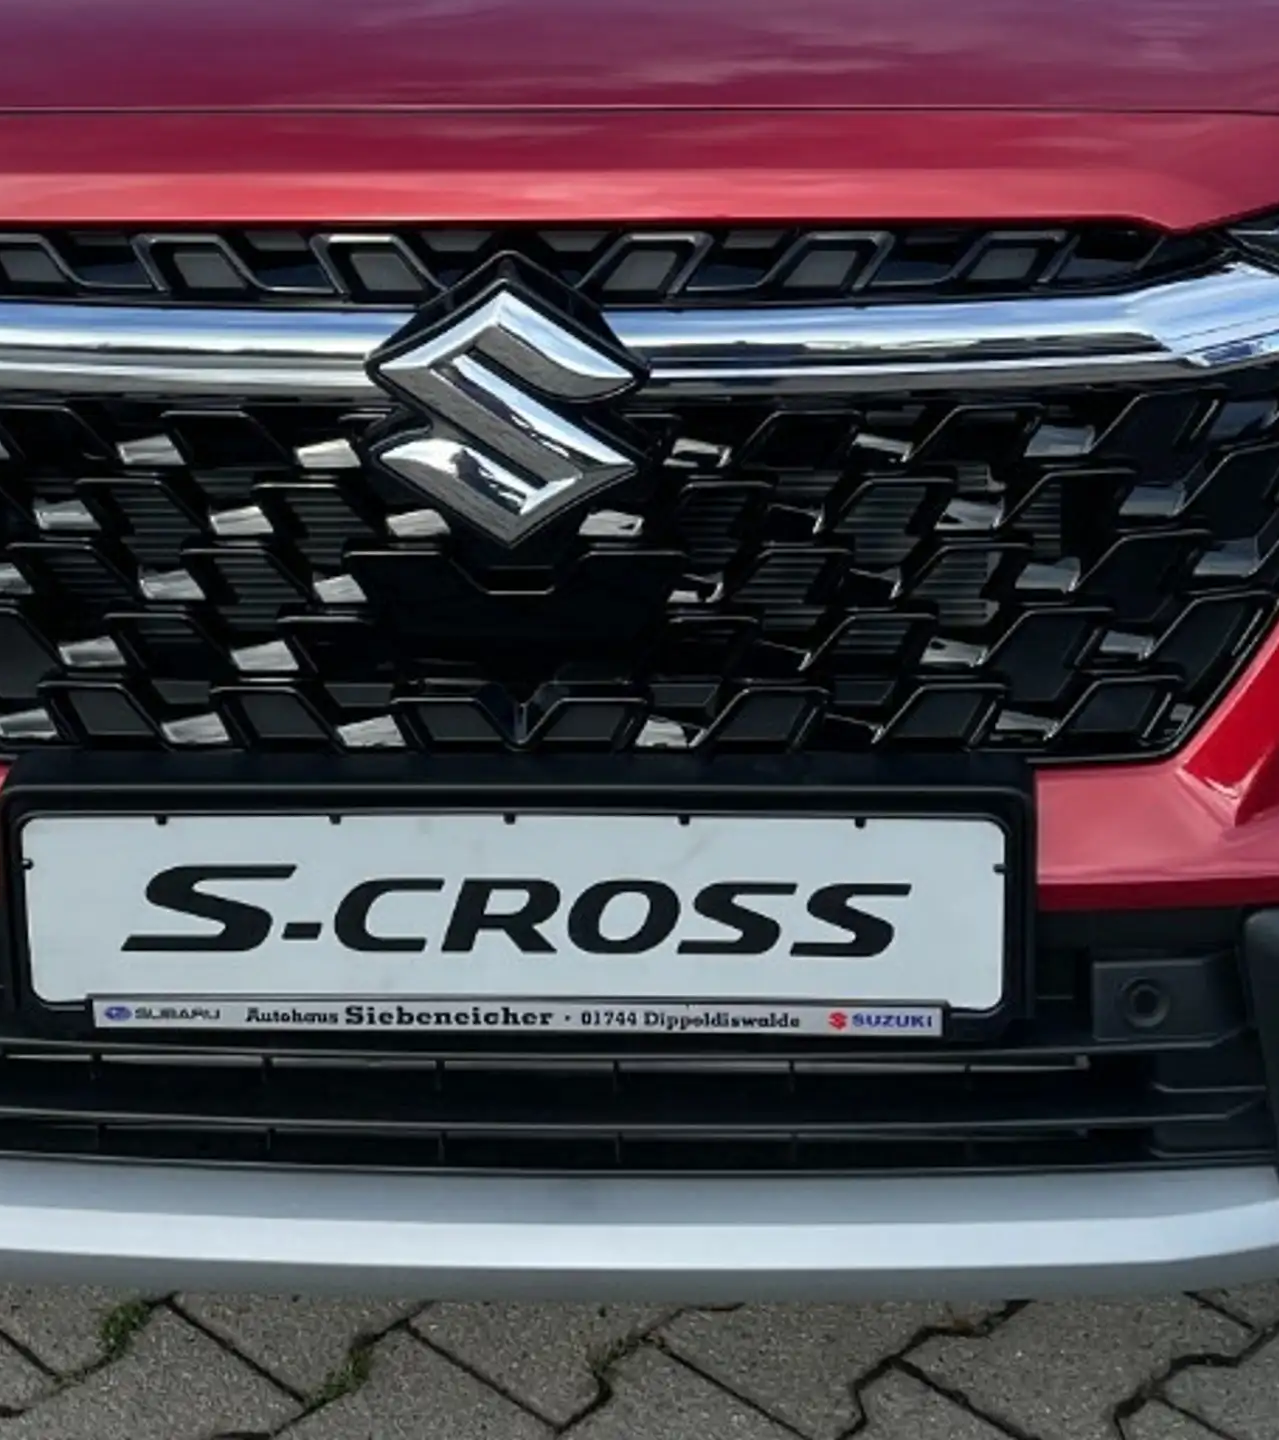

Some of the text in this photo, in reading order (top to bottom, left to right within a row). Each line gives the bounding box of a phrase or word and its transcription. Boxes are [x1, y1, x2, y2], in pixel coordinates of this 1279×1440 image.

[120, 862, 913, 959] S-CROSS
[133, 1005, 934, 1031] SUBARU Autohaus Siebeneicher 01744 Dippoldiswalde SUZUKI
